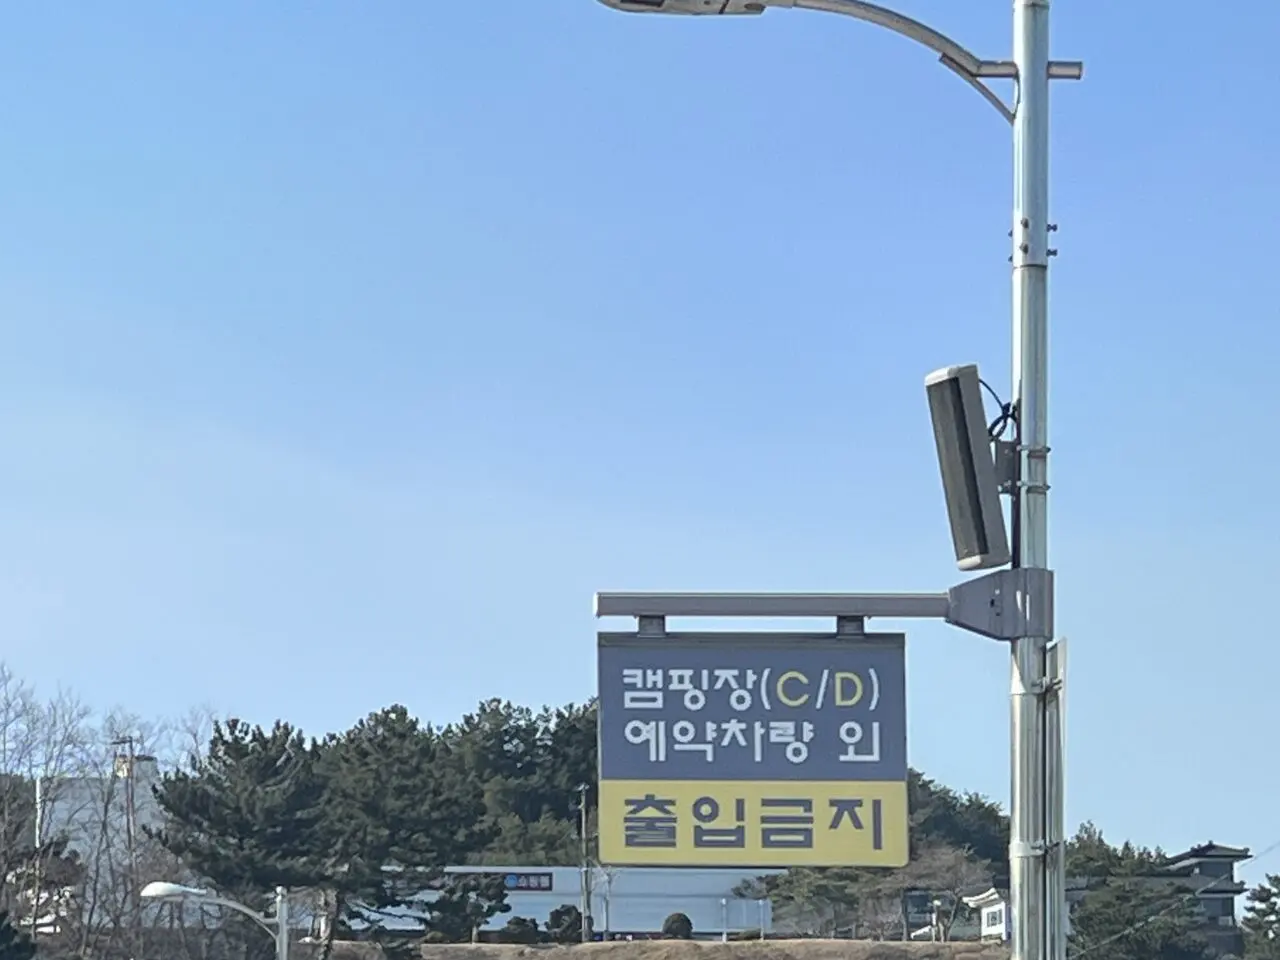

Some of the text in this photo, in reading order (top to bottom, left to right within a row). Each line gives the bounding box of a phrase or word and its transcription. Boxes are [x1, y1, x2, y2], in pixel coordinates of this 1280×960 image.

[622, 668, 880, 711] 캠핑장(C/D)
[623, 718, 881, 763] 예약차량 외
[623, 794, 883, 850] 출입금지
